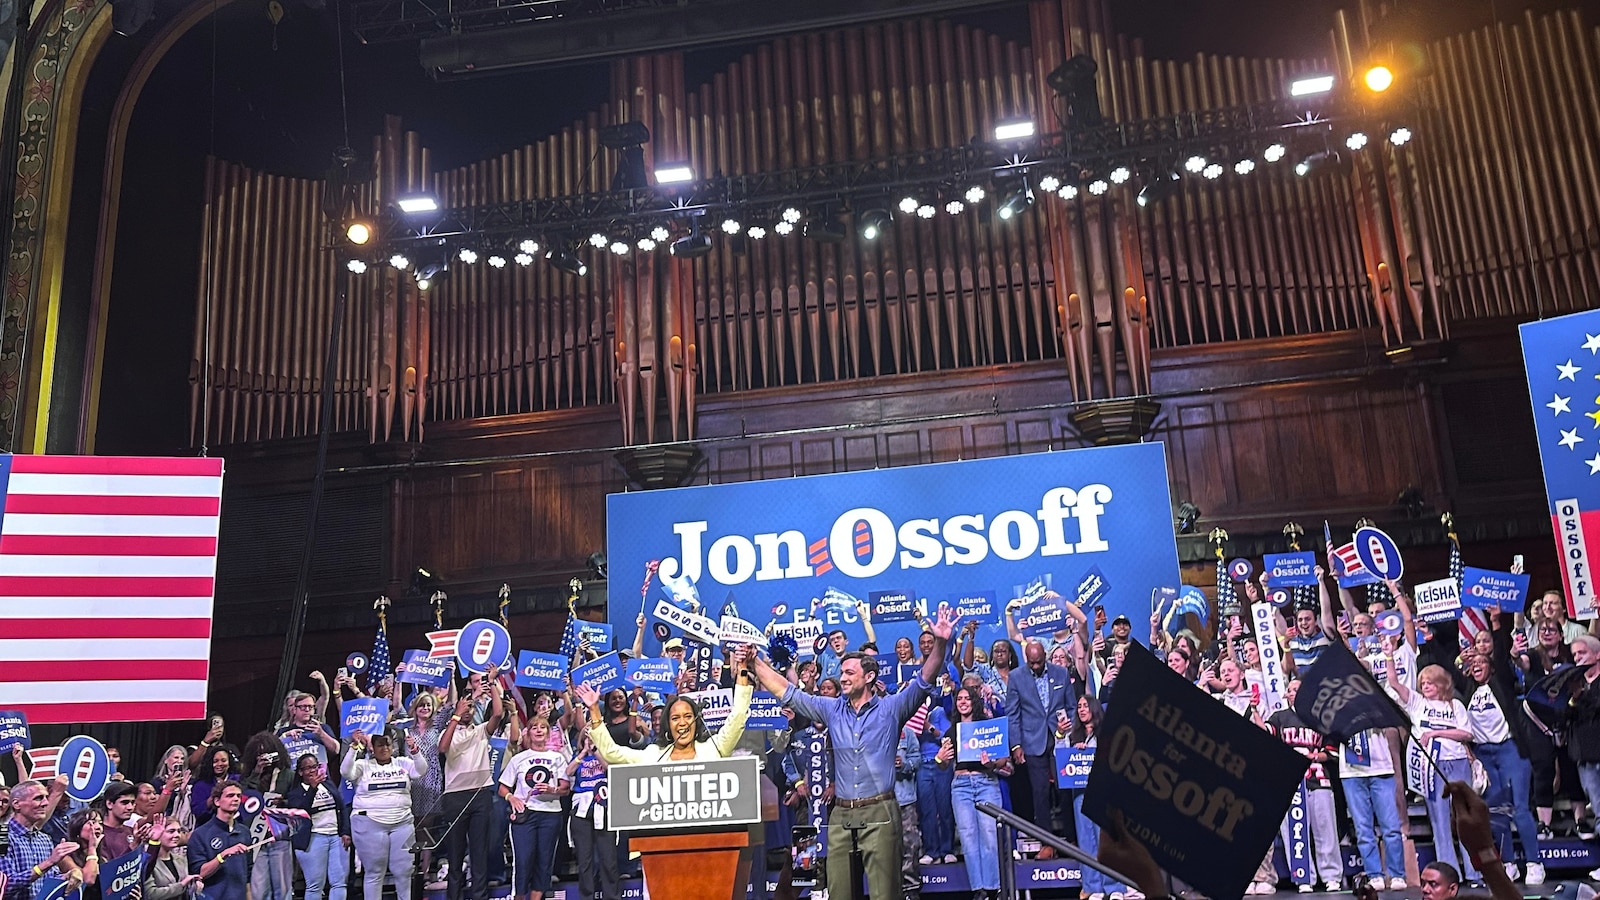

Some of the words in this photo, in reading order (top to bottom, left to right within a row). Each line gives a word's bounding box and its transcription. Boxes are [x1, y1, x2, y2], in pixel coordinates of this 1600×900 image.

[657, 521, 811, 586] Jon
[829, 484, 1112, 578] Ossoff
[1276, 558, 1304, 566] Atlanta
[1273, 565, 1310, 577] Ossoff
[1479, 576, 1515, 587] Atlanta
[1417, 585, 1456, 604] KEISHA
[1471, 584, 1520, 600] Ossoff
[876, 601, 911, 614] Ossoff
[955, 604, 991, 616] Ossoff
[1030, 603, 1056, 614] Atlanta
[1434, 600, 1457, 608] BOTTOMS
[1027, 610, 1062, 626] Ossoff
[1424, 611, 1455, 621] GOVERNOR
[414, 656, 442, 665] Atlanta
[531, 658, 559, 666] Atlanta
[406, 662, 445, 677] Ossoff
[524, 665, 562, 679] Ossoff
[583, 663, 610, 678] Atlanta
[632, 671, 673, 682] Ossoff
[750, 697, 776, 705] tlanta
[346, 713, 381, 726] Ossoff
[973, 726, 999, 735] Atlanta
[1137, 694, 1247, 779] Atlanta
[968, 734, 1003, 749] Ossoff
[290, 745, 319, 759] ssoff
[1069, 753, 1095, 761] Atlant
[1164, 743, 1187, 764] for
[1066, 764, 1091, 776] Oss
[1411, 746, 1423, 791] KEISH
[628, 772, 740, 805] UNITED
[1109, 725, 1253, 843] Ossoff
[650, 801, 732, 822] GEORGIA
[1032, 869, 1055, 881] Jon
[1057, 868, 1081, 880] Oss
